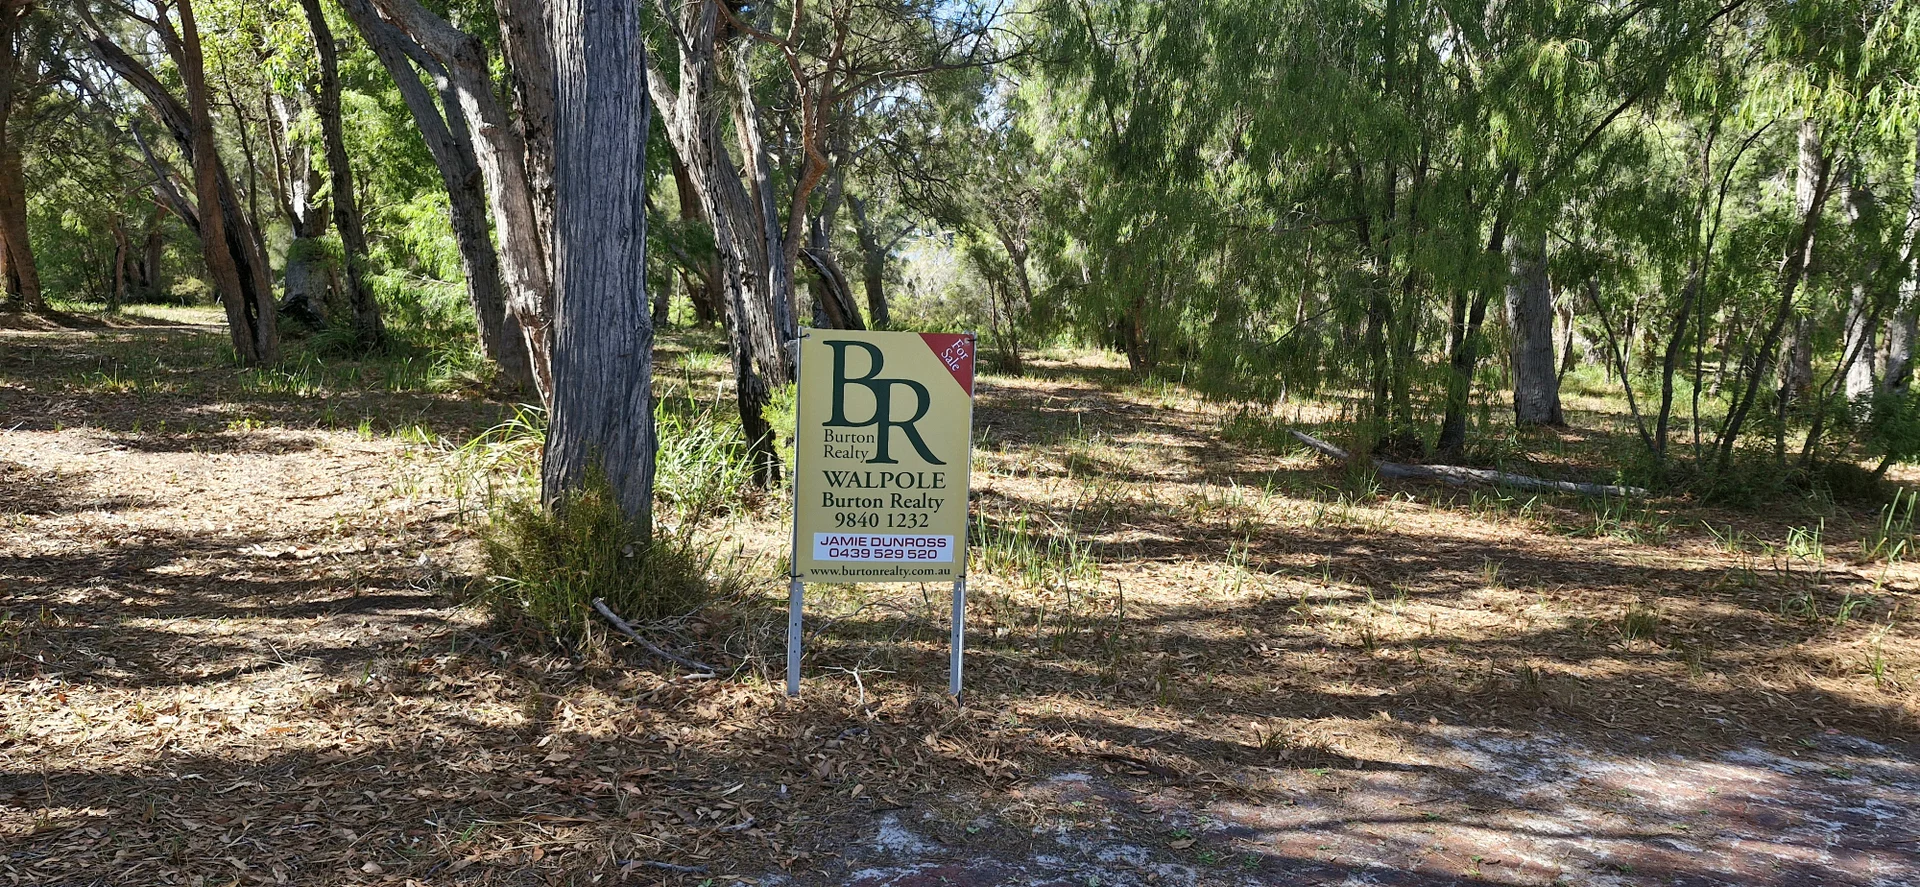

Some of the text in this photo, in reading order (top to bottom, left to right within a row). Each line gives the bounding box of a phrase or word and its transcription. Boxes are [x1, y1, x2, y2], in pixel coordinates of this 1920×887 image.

[951, 338, 969, 361] For
[940, 347, 961, 372] Sale
[823, 429, 875, 443] Burton
[823, 445, 869, 463] Realty
[822, 470, 947, 489] WALPOLE
[821, 491, 945, 513] Burton Realty
[834, 511, 929, 528] 9840 1232
[820, 535, 947, 547] JAMIE DUNROSS
[829, 547, 938, 560] 0439 529 520
[810, 565, 951, 579] www.burtonrealty.com.au
